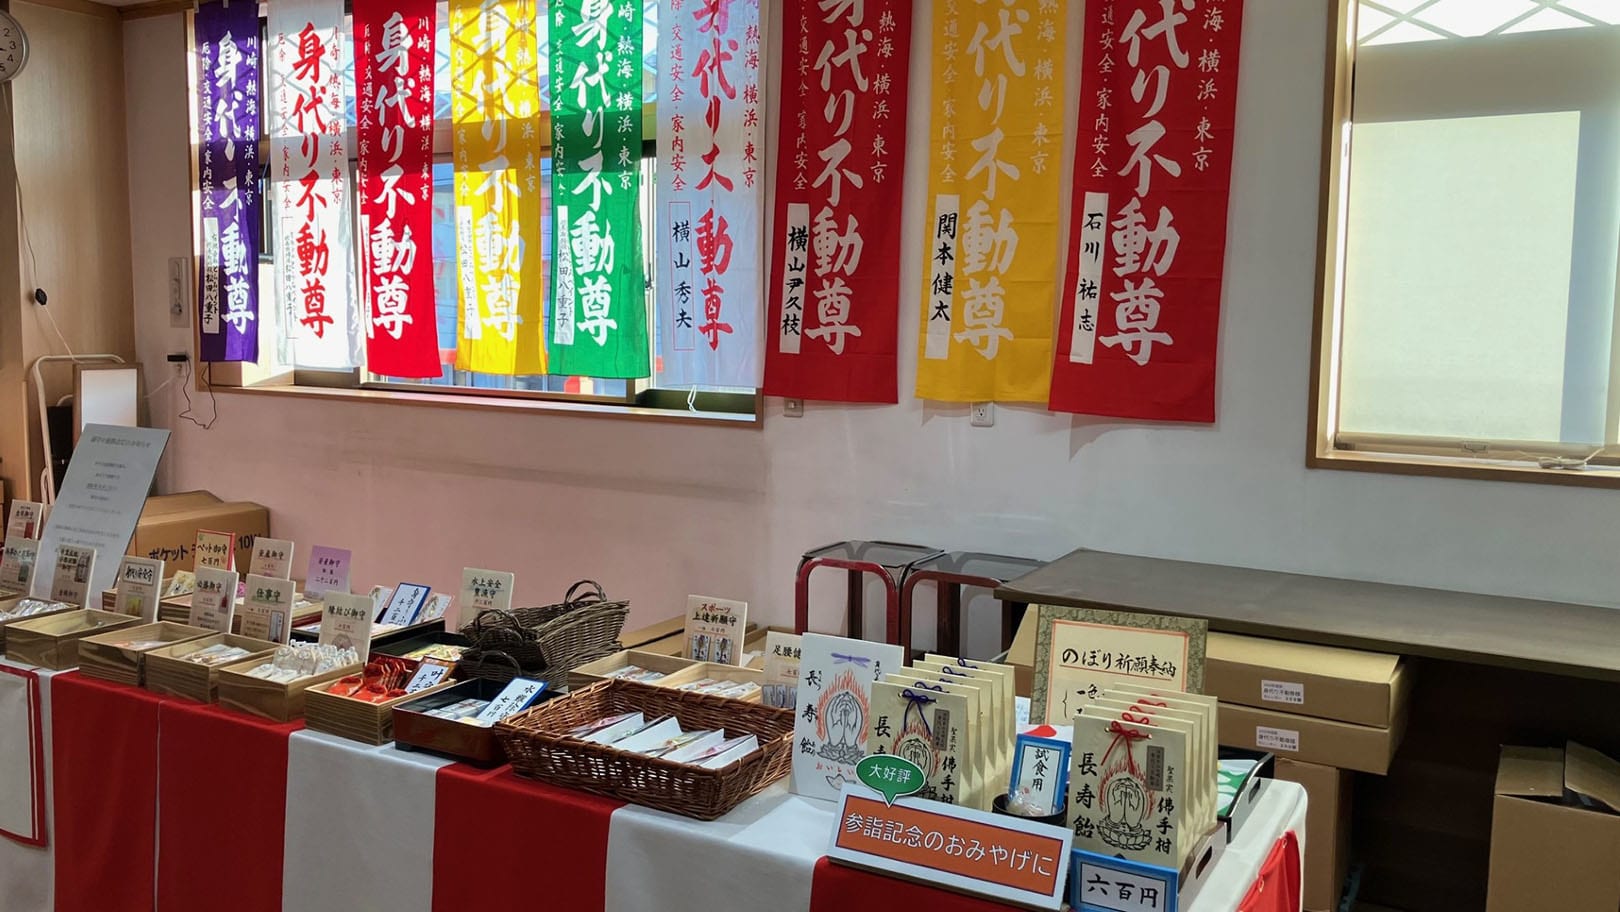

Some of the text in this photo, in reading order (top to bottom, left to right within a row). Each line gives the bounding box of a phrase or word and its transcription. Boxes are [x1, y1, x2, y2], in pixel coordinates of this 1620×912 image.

[292, 22, 334, 339] 身代り不動尊
[371, 11, 418, 340] 身代り不動尊
[472, 0, 524, 342] 身代り不動尊
[569, 0, 618, 346] 身代り不動尊
[672, 220, 693, 329] 横山秀夫
[930, 211, 958, 322] 関本健太
[1077, 211, 1104, 332] 石川祐志
[148, 544, 189, 561] ポケット
[471, 577, 502, 589] 水上安全
[701, 603, 731, 613] スポーツ
[1062, 648, 1176, 678] のぼり祈願奉納
[800, 670, 819, 755] 長寿飴
[869, 764, 912, 784] 大好評
[1031, 748, 1049, 792] 試食用
[1072, 753, 1099, 839] 長寿飴
[845, 812, 1054, 877] 参詣記念のおみやげに
[1155, 796, 1175, 854] 佛手柑
[1086, 873, 1160, 908] 六百円
